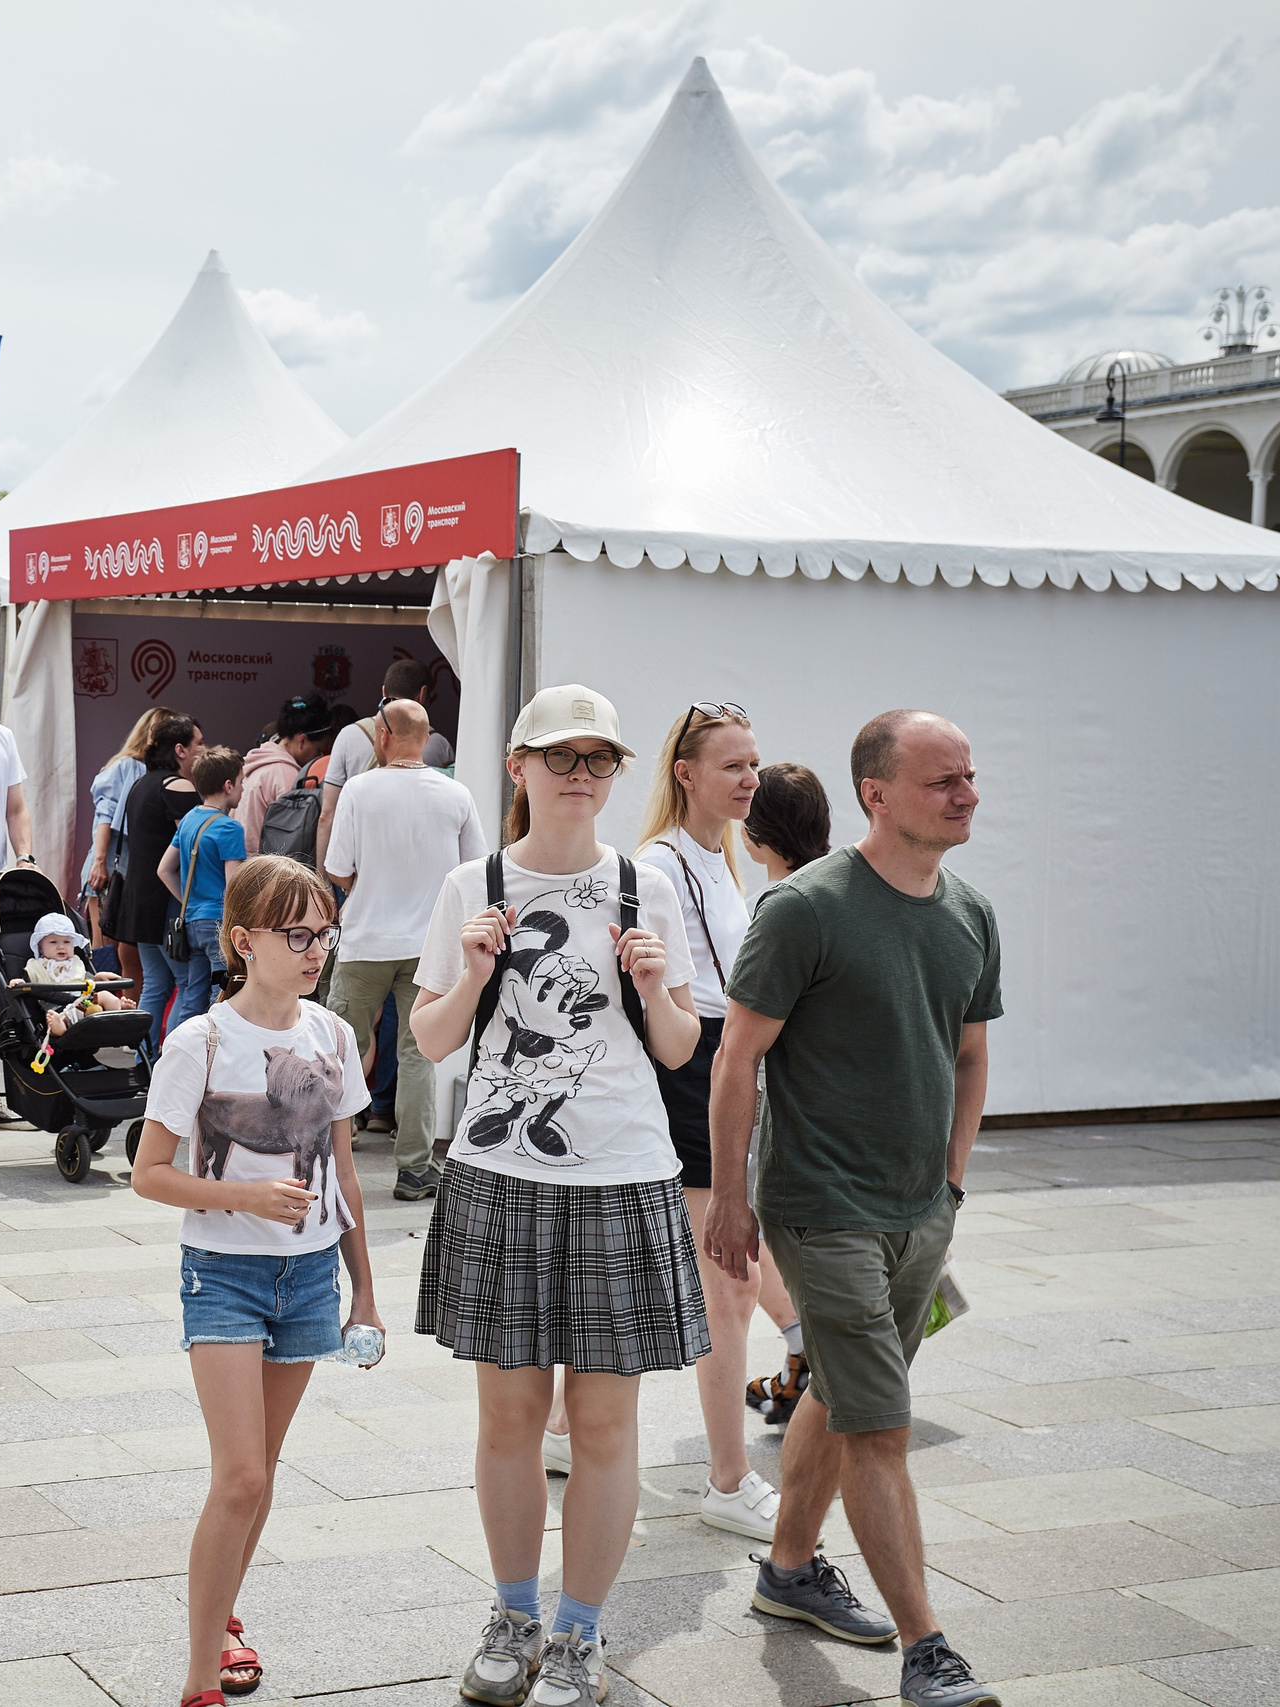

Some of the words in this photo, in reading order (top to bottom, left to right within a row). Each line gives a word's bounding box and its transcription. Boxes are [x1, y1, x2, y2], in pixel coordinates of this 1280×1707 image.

[427, 501, 466, 516] Московский
[427, 517, 459, 530] транспорт
[187, 650, 273, 665] Московский
[187, 670, 258, 684] транспорт
